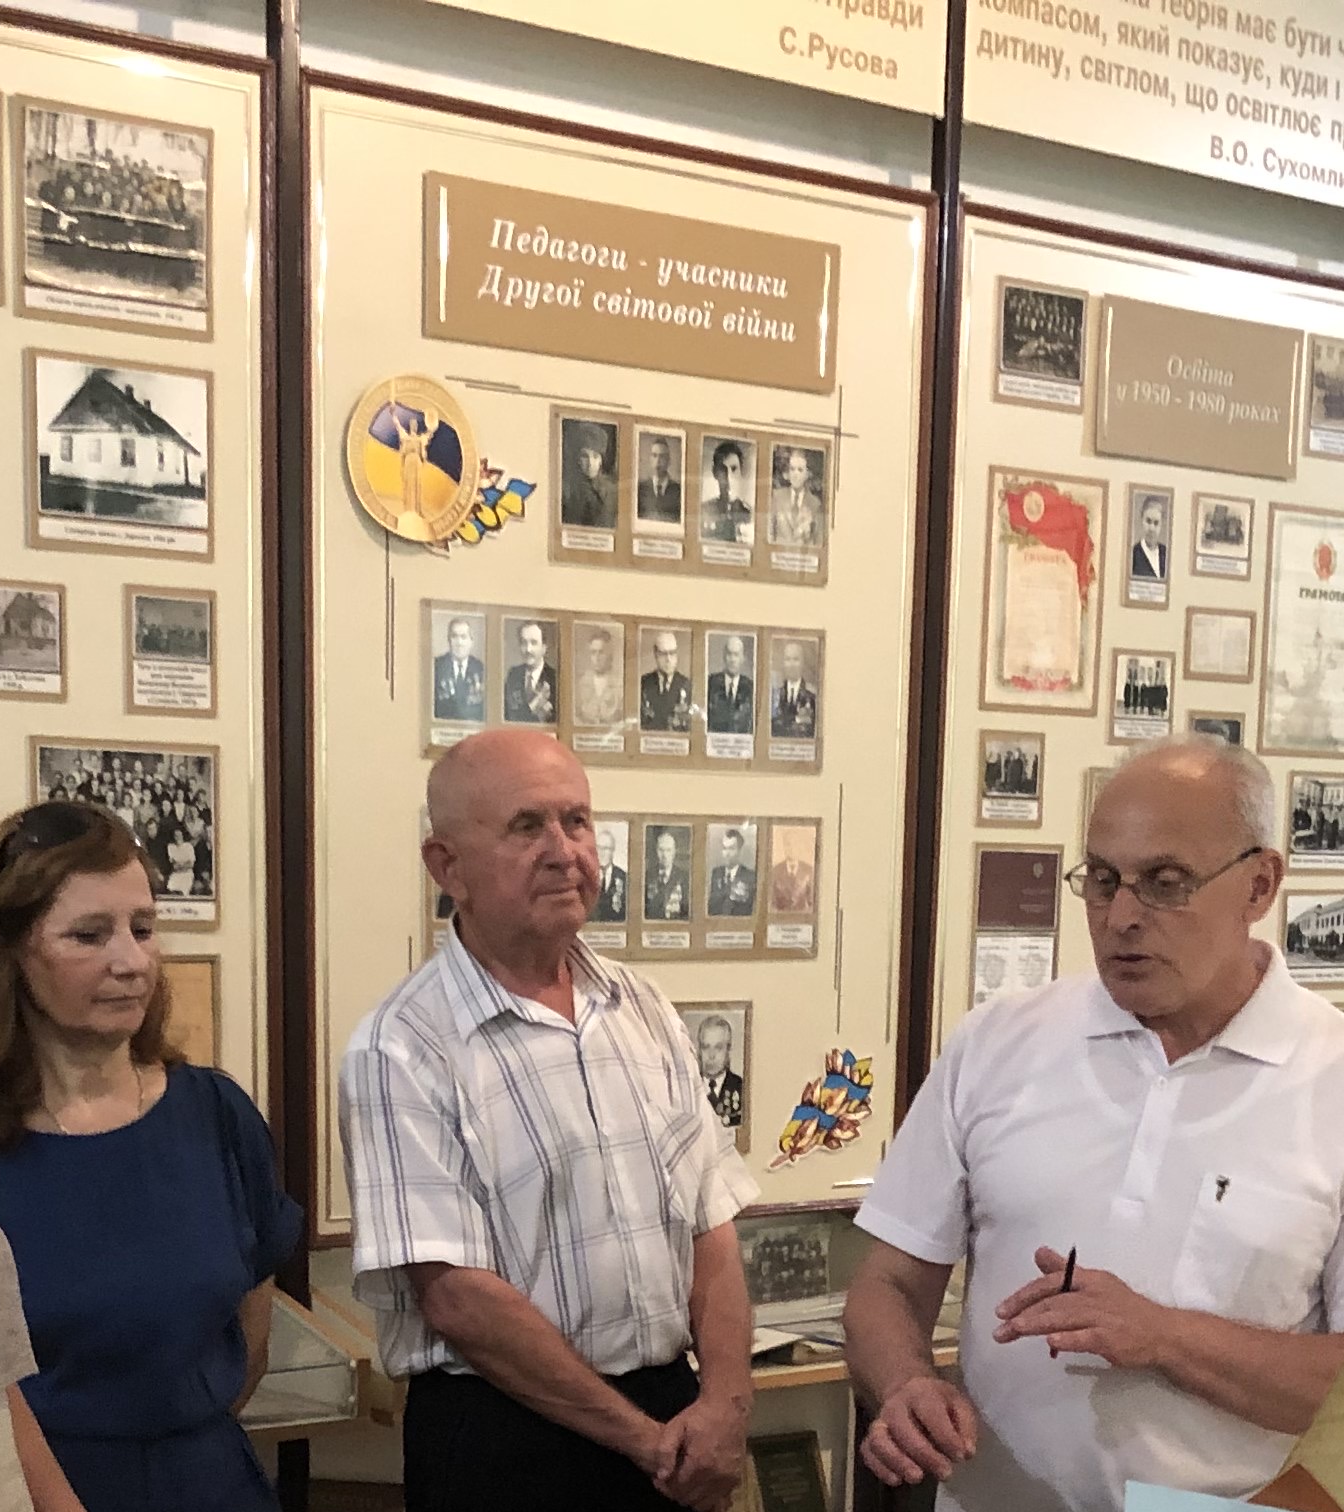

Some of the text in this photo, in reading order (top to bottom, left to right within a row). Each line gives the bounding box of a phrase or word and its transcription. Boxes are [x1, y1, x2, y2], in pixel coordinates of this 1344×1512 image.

[778, 26, 898, 80] С.Русова
[1117, 21, 1170, 56] який
[1177, 37, 1271, 90] показує,
[1279, 64, 1328, 100] куди
[1235, 12, 1277, 43] має
[1284, 17, 1331, 58] бути
[976, 28, 1071, 82] дитину,
[1080, 54, 1177, 107] світлом,
[1185, 82, 1218, 113] що
[1225, 92, 1322, 138] освітлює
[490, 218, 628, 273] Педагоги
[657, 256, 788, 299] учасники
[477, 263, 796, 343] Другої світової війни
[1166, 354, 1235, 388] Освіта
